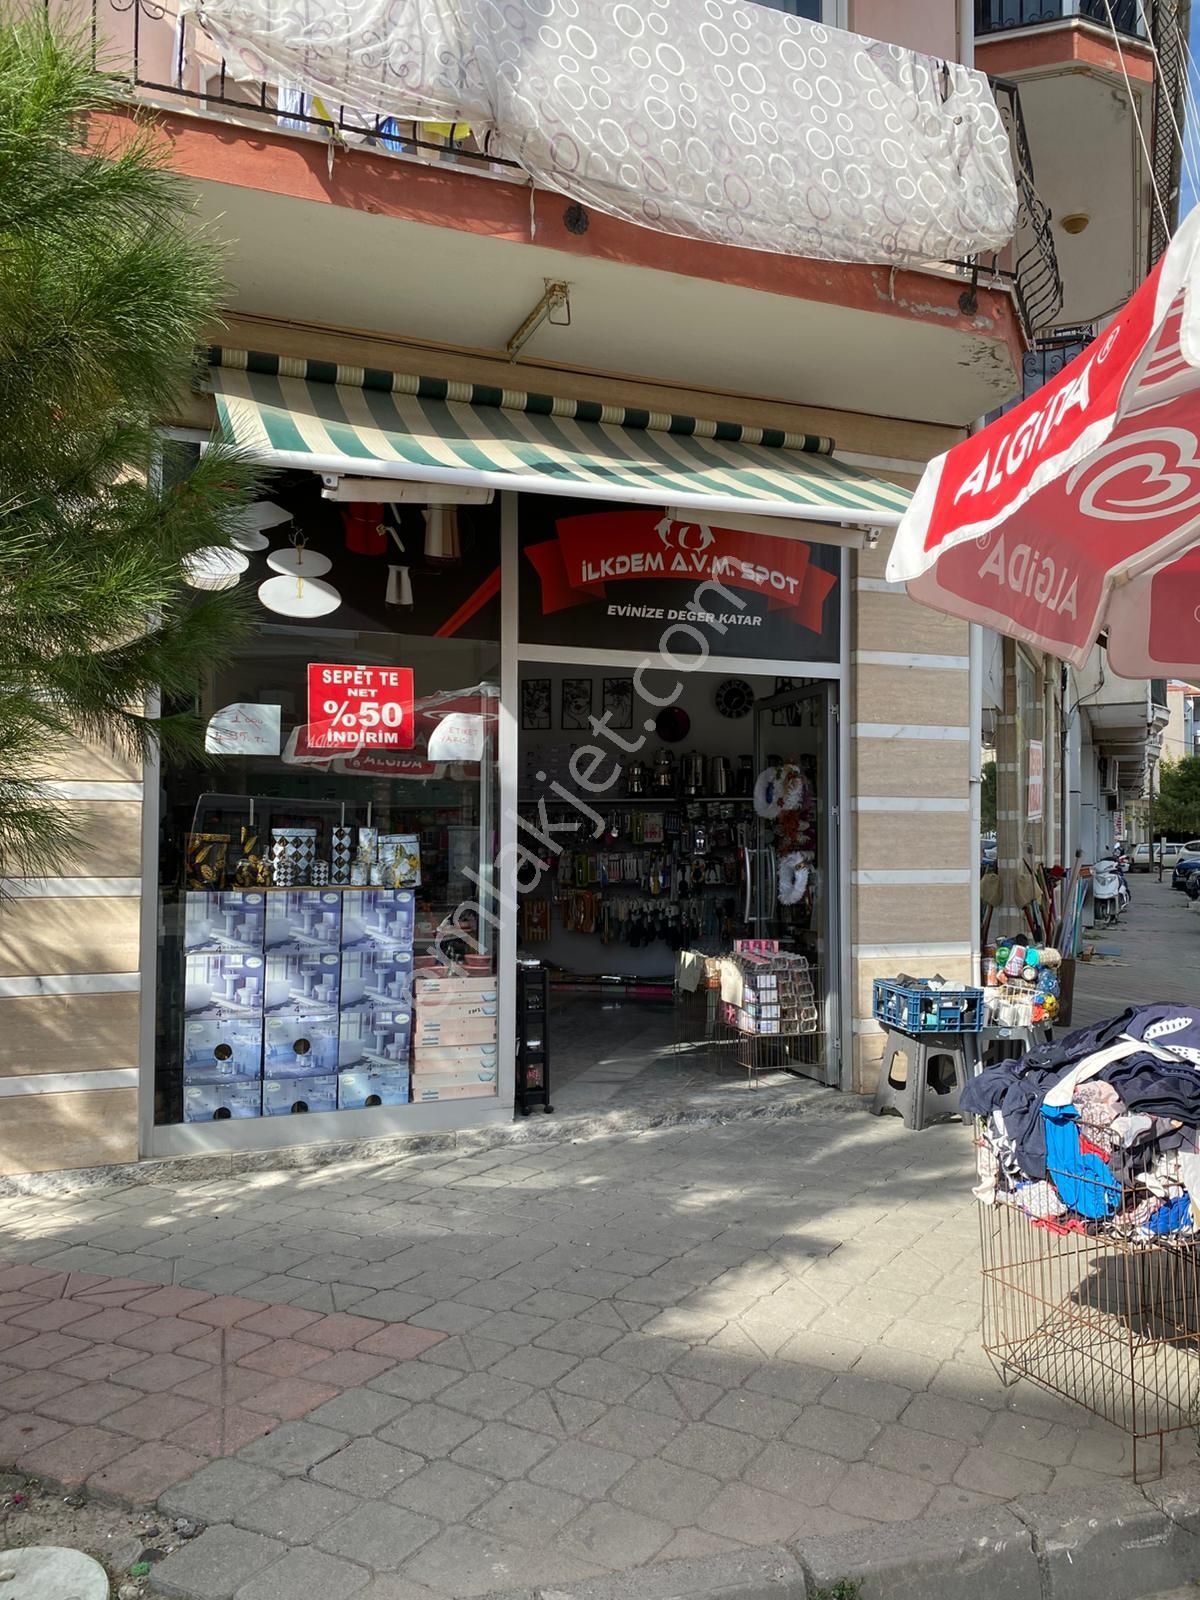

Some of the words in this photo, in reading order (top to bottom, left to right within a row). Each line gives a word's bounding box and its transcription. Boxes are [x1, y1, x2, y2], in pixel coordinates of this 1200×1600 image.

[581, 552, 665, 583] İLKDEM
[740, 561, 800, 595] SPOT
[607, 603, 664, 620] EVİNİZE
[718, 613, 762, 626] KATAR
[322, 669, 373, 685] SEPET
[379, 671, 399, 687] TE
[347, 687, 378, 698] NET
[323, 700, 403, 728] %50
[327, 728, 399, 744] İNDİRİM
